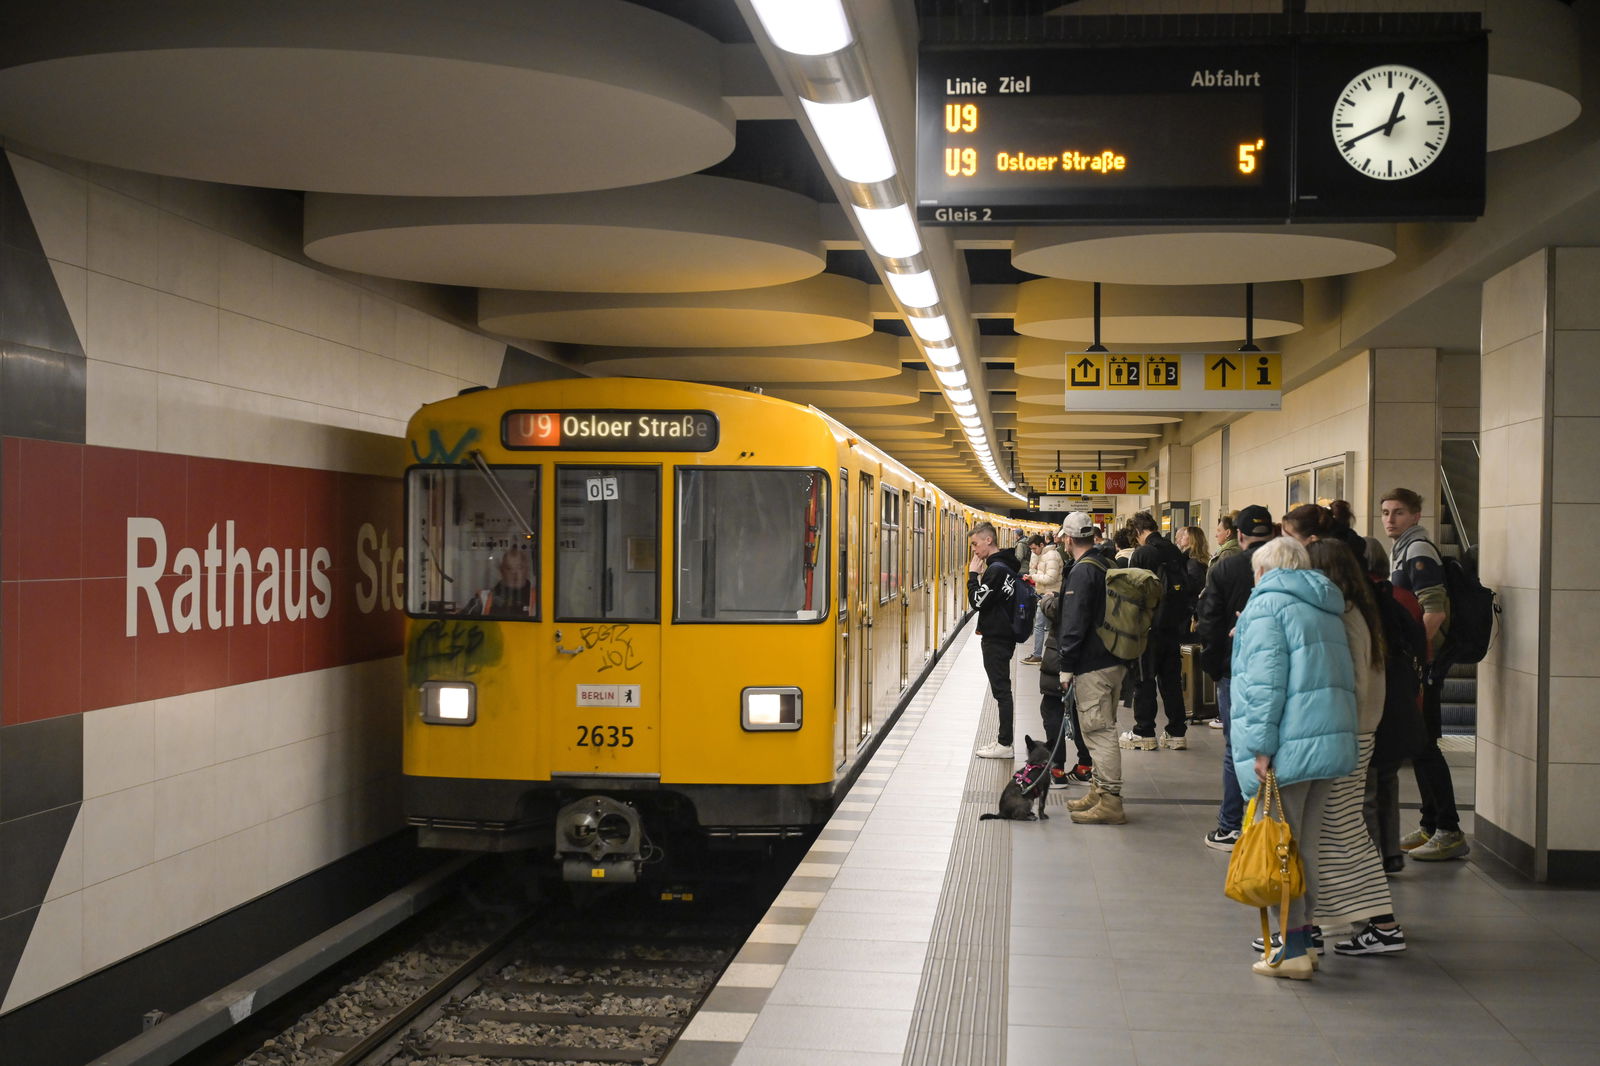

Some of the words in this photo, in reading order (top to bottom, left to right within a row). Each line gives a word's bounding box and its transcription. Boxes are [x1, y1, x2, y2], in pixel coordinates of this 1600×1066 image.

[946, 77, 987, 95] Linie
[999, 76, 1031, 93] Ziel
[1191, 70, 1261, 88] Abfahrt
[945, 104, 977, 133] U9
[945, 148, 977, 177] U9
[996, 151, 1058, 173] Osloer
[1062, 150, 1126, 175] Straße
[935, 208, 977, 222] Gleis
[982, 208, 993, 222] 2
[1129, 366, 1138, 381] 2
[1167, 366, 1176, 381] 3
[519, 414, 552, 438] U9
[563, 415, 632, 437] Osloer
[638, 415, 708, 437] Straße
[126, 517, 332, 637] Rathaus
[581, 691, 615, 701] BERLIN
[576, 725, 634, 747] 2635
